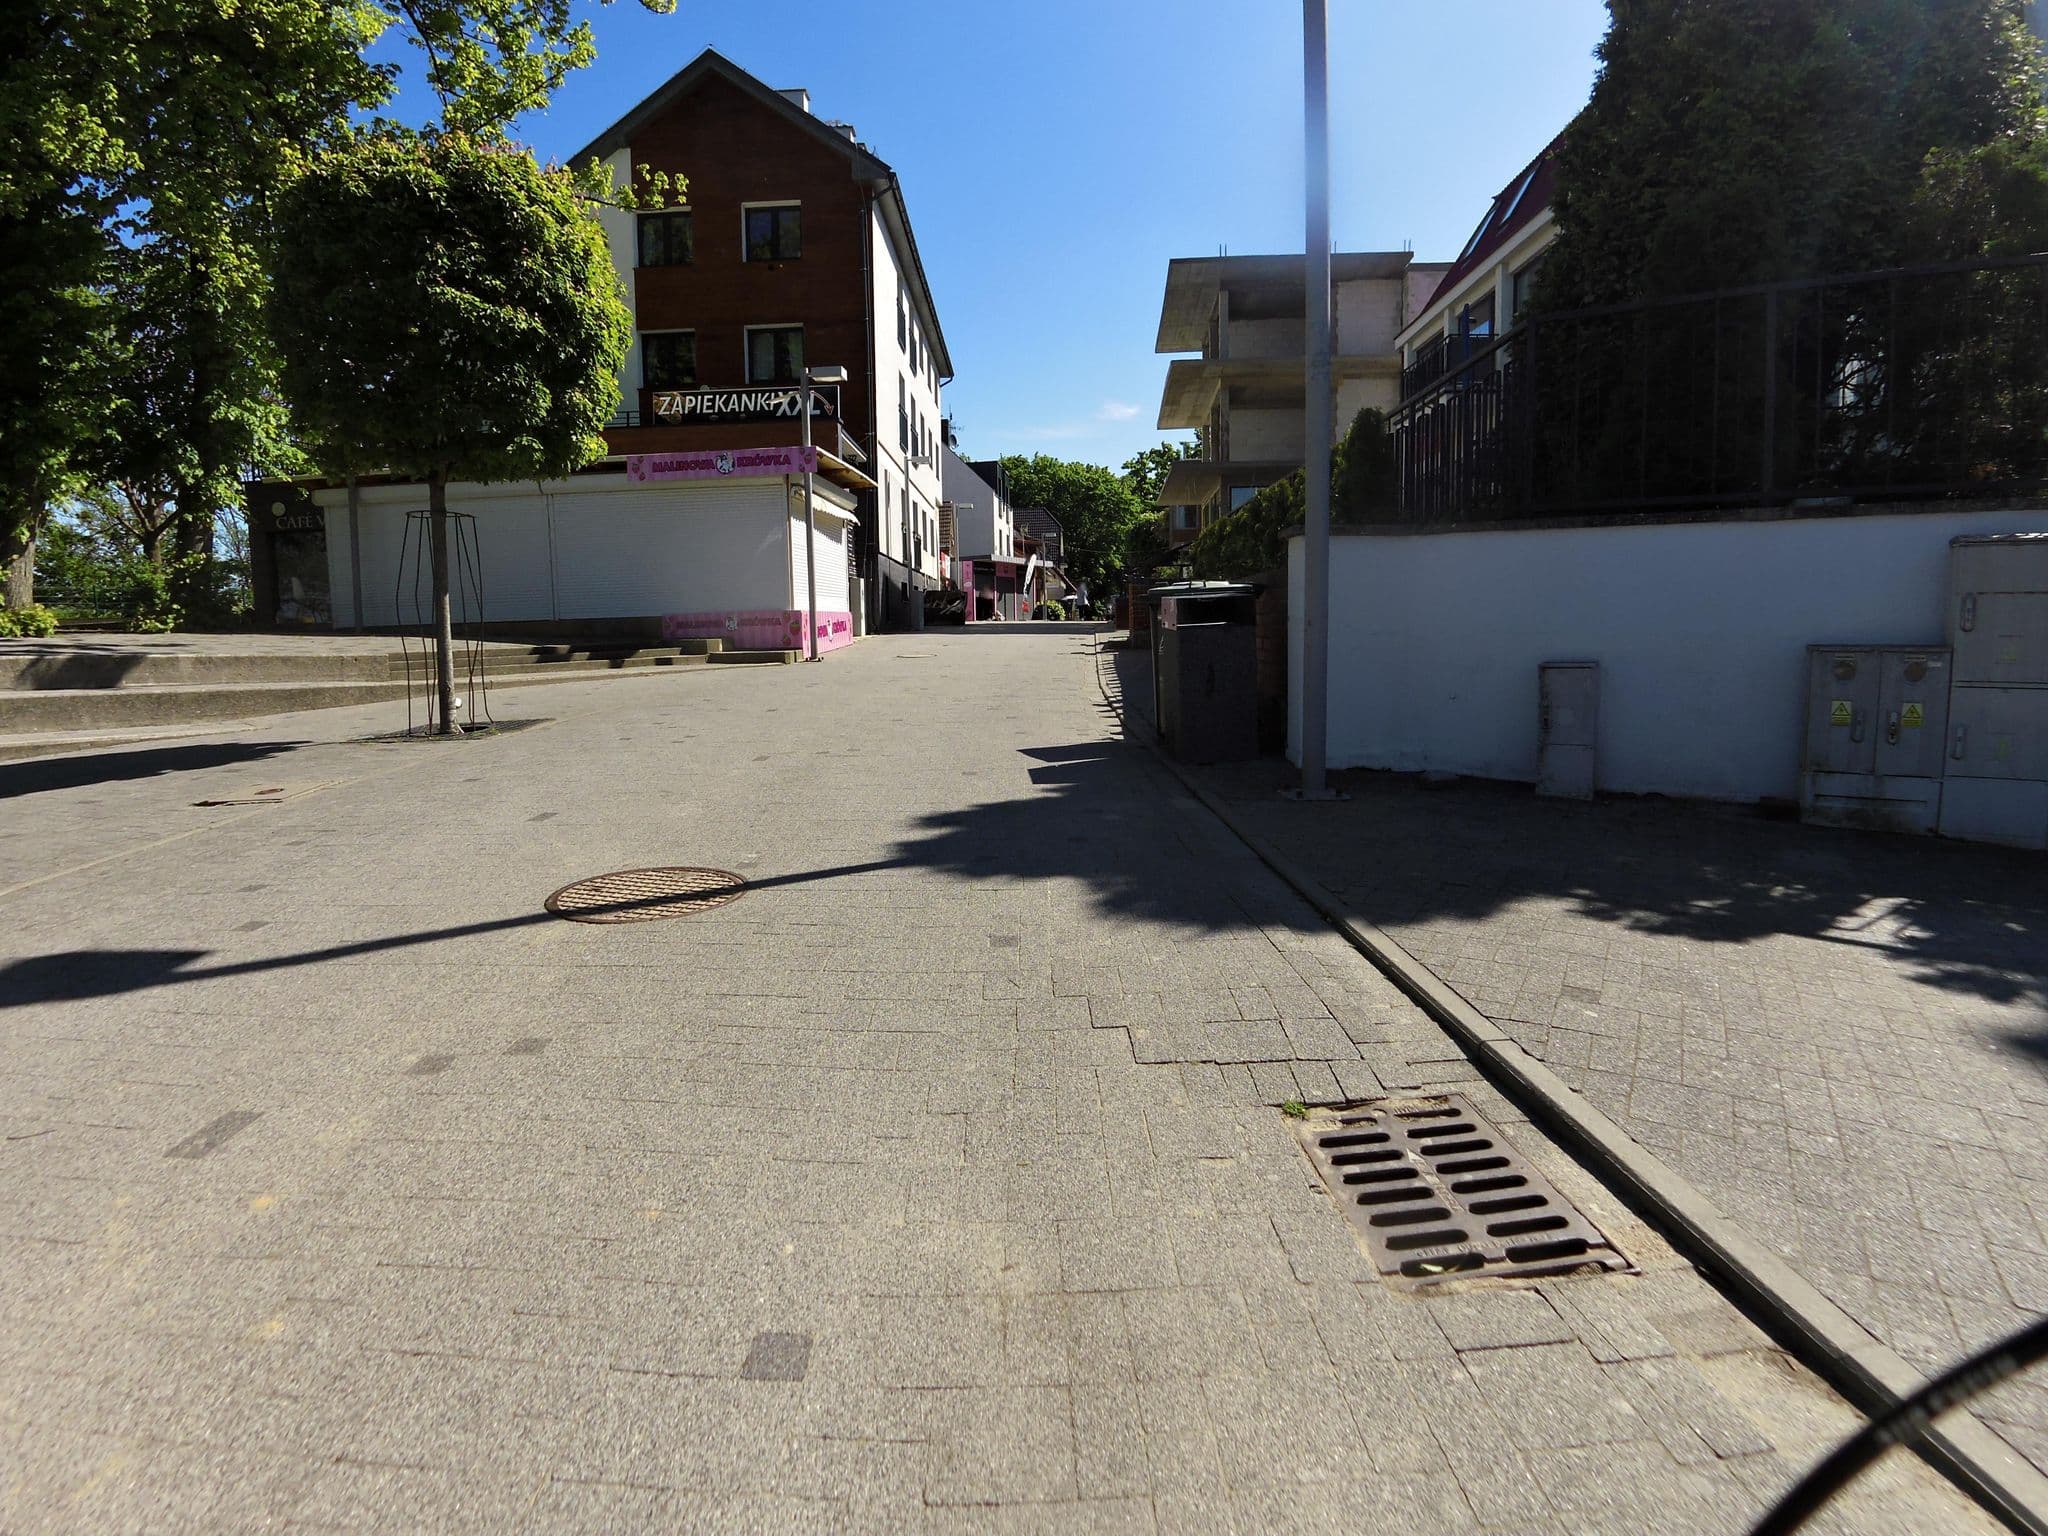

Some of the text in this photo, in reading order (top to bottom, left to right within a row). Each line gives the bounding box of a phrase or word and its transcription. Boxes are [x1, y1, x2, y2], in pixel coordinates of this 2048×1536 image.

[658, 393, 775, 415] ZAPIEKANKI
[652, 452, 791, 472] MALINOWA KRÓWKA
[276, 512, 312, 528] CAFÉ
